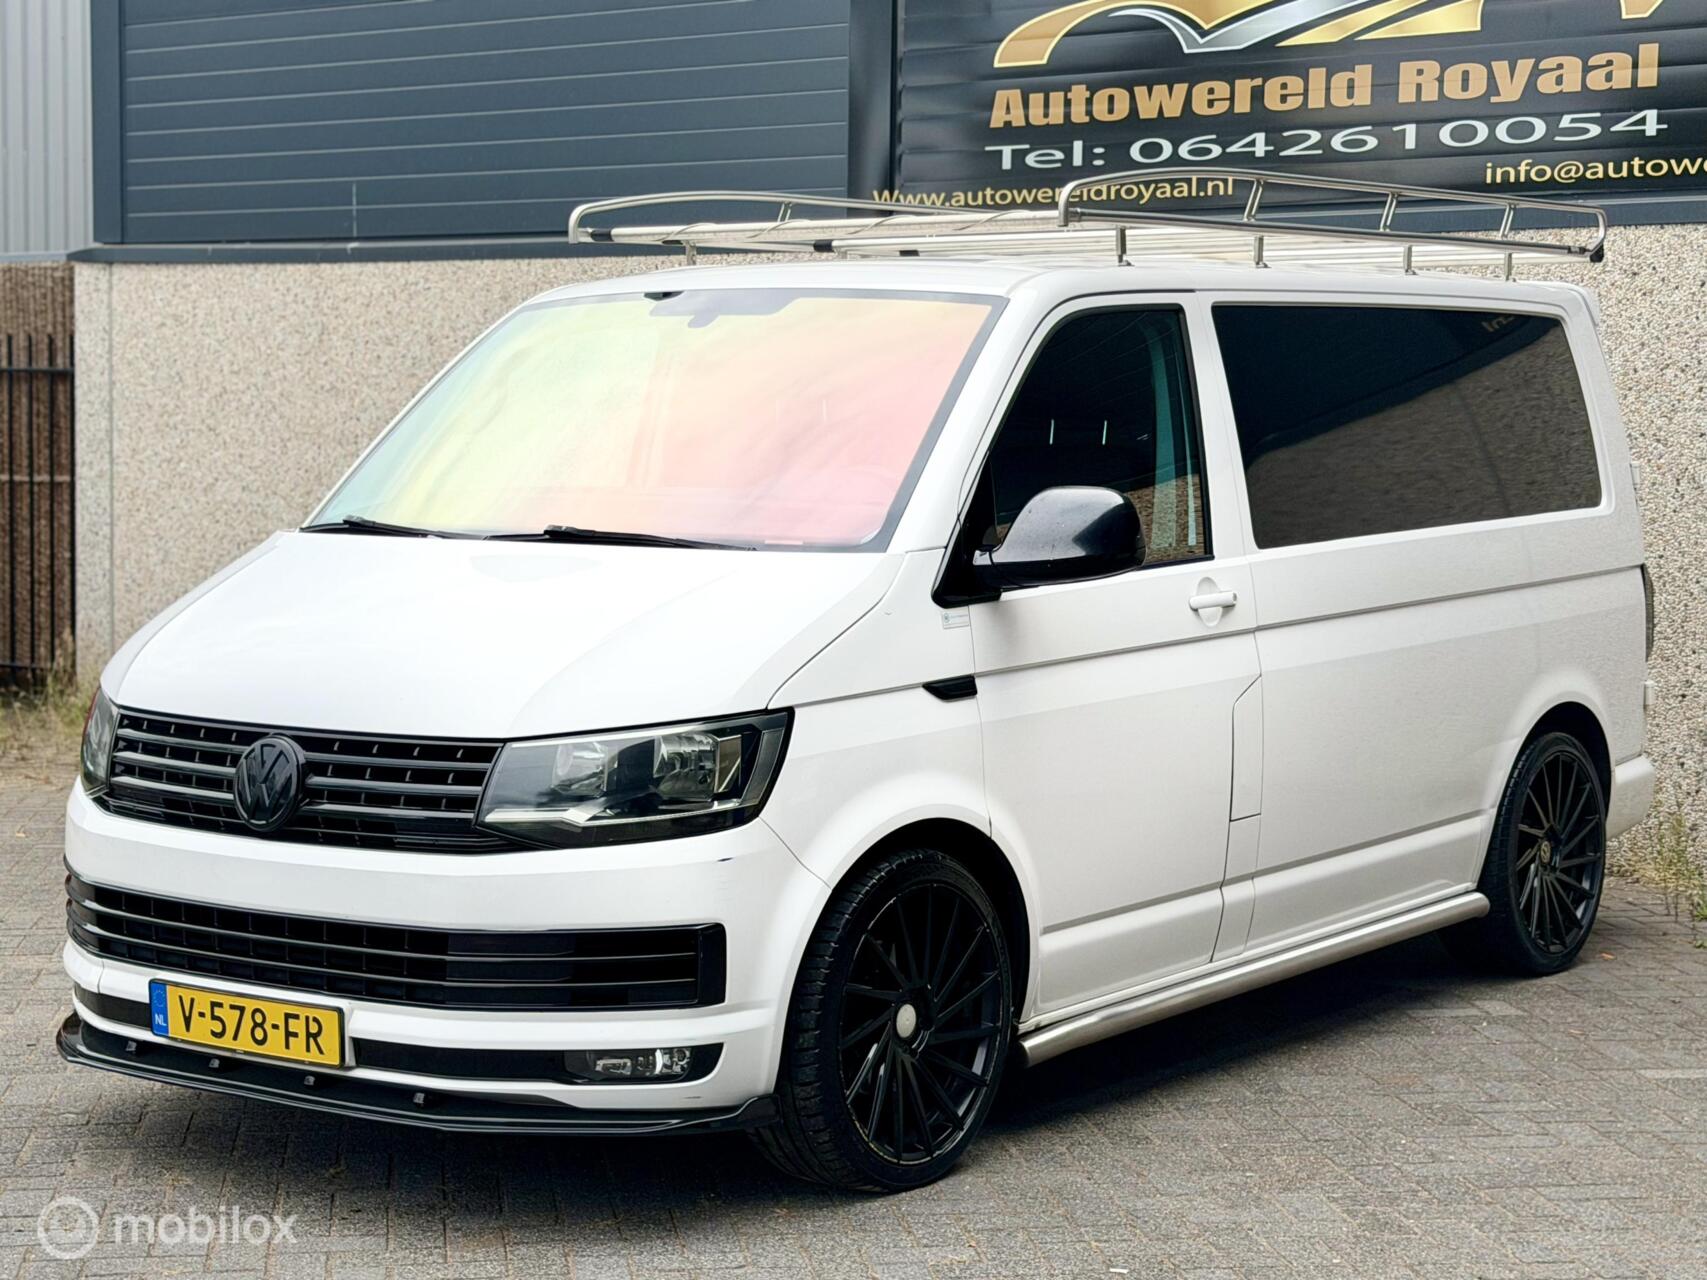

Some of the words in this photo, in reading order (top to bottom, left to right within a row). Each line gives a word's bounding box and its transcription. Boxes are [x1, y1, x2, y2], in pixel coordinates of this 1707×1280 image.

[989, 64, 1373, 129] Autowereld
[1398, 43, 1660, 103] Royaal
[985, 140, 1106, 170] Tel:
[1129, 109, 1668, 164] 0642610054
[1486, 156, 1707, 184] info@autow
[154, 1013, 167, 1027] NL
[178, 995, 325, 1056] V-578-FR
